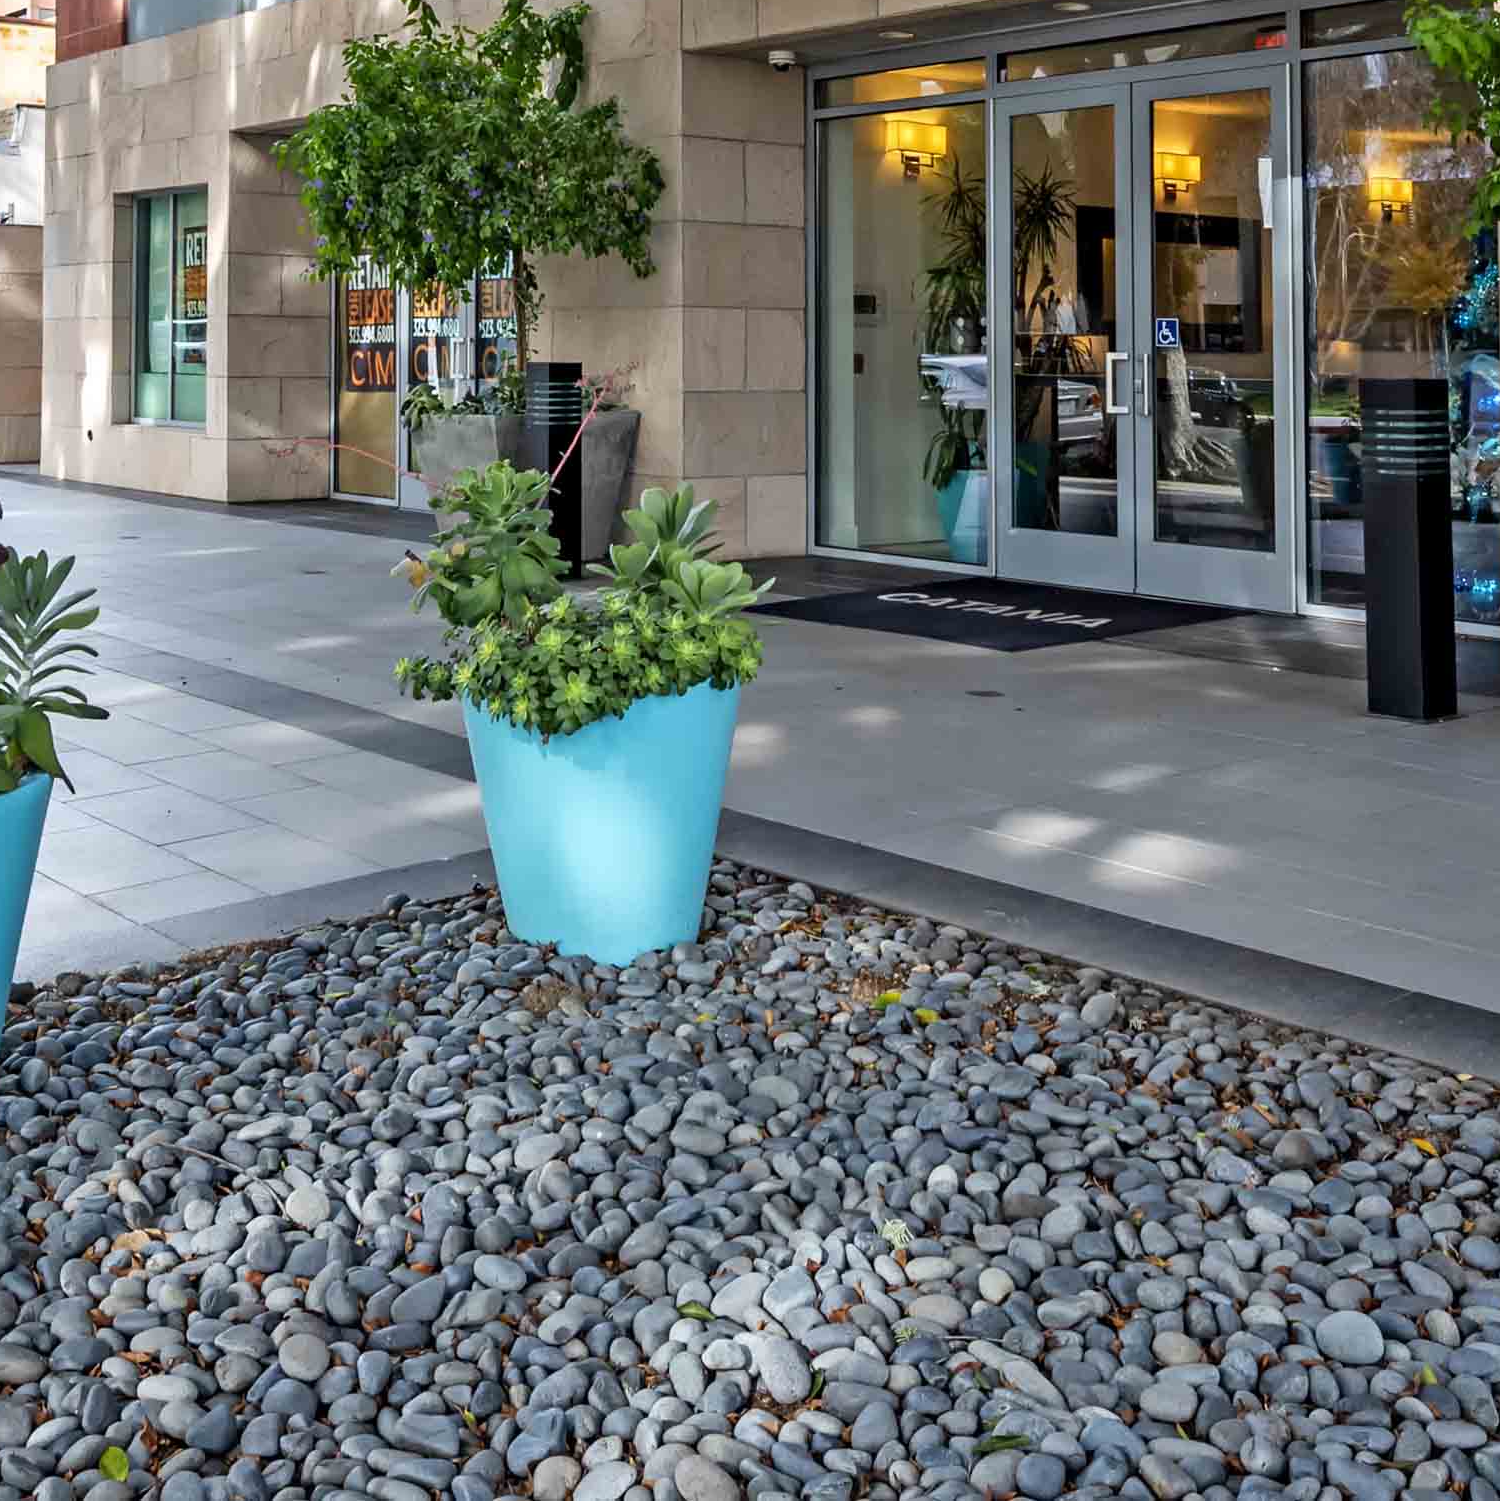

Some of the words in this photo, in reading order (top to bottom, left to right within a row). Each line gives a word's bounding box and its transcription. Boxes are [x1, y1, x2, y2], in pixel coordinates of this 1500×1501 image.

[413, 318, 460, 337] 323.994.680
[351, 349, 395, 386] CIM
[877, 593, 1113, 628] CATANIA
